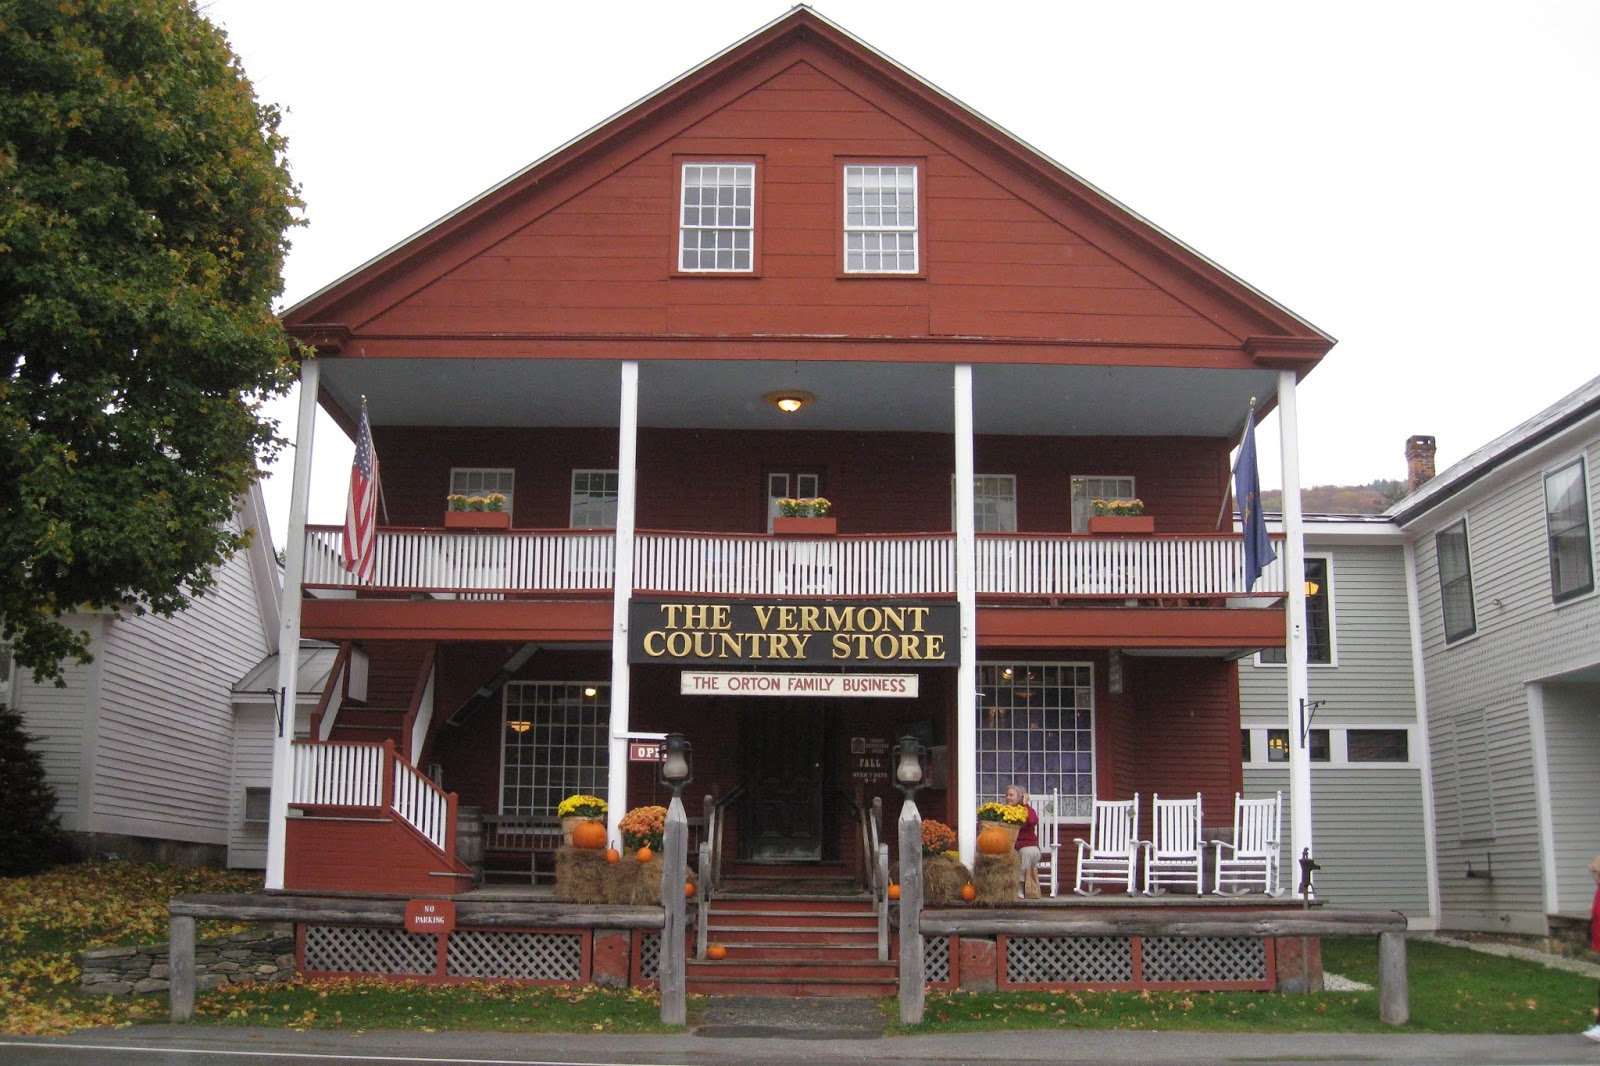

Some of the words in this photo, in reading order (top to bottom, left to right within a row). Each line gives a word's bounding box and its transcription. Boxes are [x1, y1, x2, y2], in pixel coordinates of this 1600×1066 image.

[661, 604, 732, 630] THE
[753, 605, 929, 632] VERMONT
[643, 631, 811, 659] COUNTRY
[832, 633, 946, 660] STORE
[693, 676, 719, 690] THE
[728, 676, 781, 691] ORTON
[788, 678, 834, 692] FAMILY
[843, 678, 906, 693] BUSINESS
[638, 747, 668, 758] OPE
[860, 758, 880, 768] FALL
